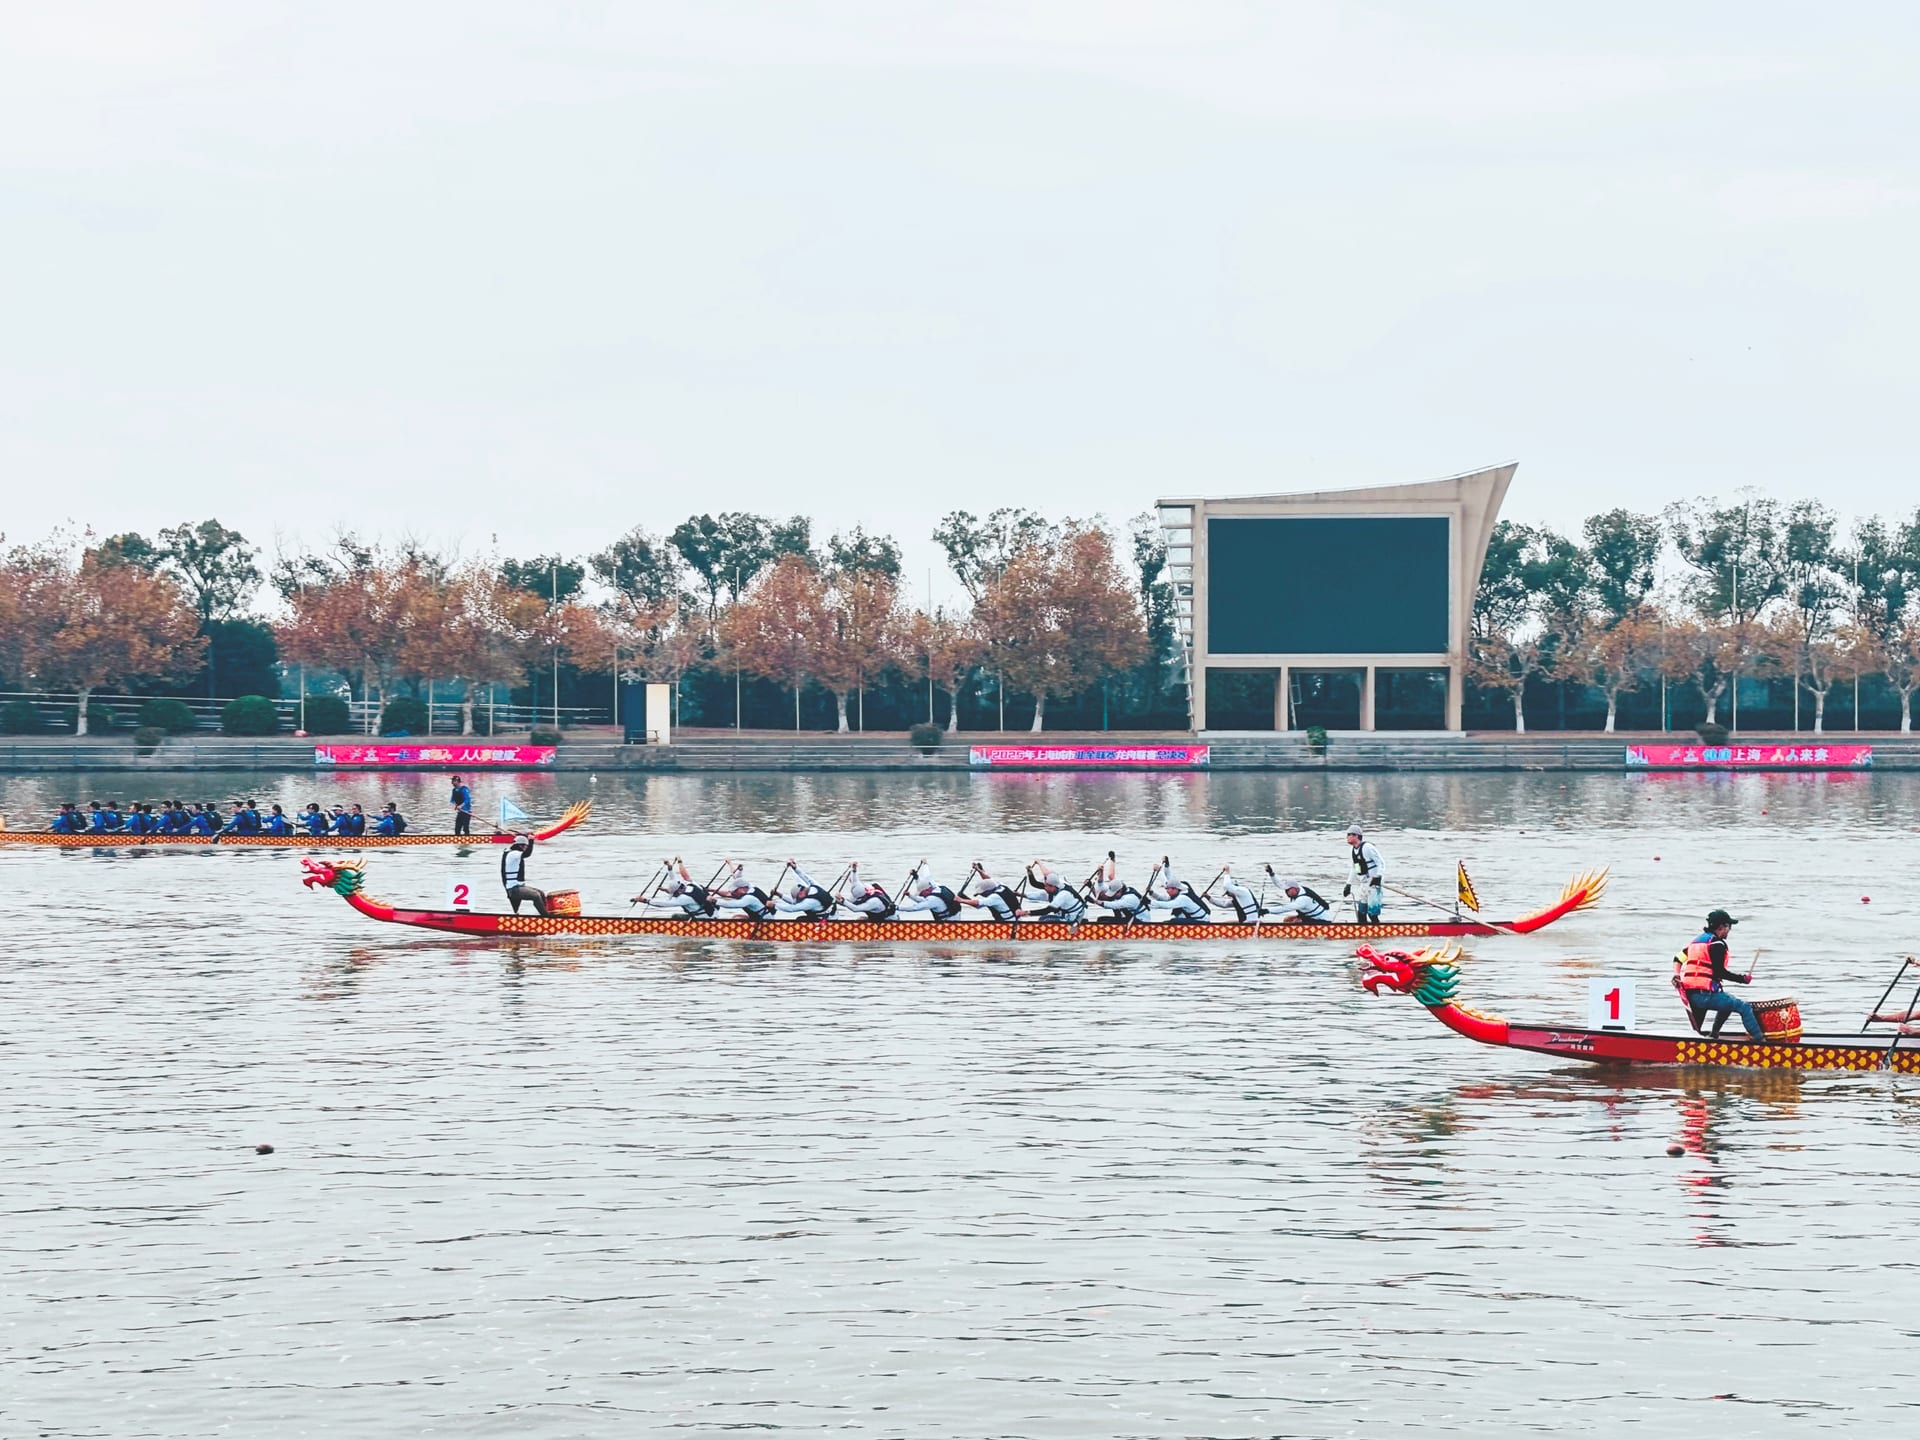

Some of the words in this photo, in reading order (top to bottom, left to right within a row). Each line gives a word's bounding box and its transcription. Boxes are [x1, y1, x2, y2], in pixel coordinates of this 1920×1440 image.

[1770, 748, 1829, 762] 人人来赛
[453, 884, 469, 905] 2
[1604, 988, 1620, 1020] 1
